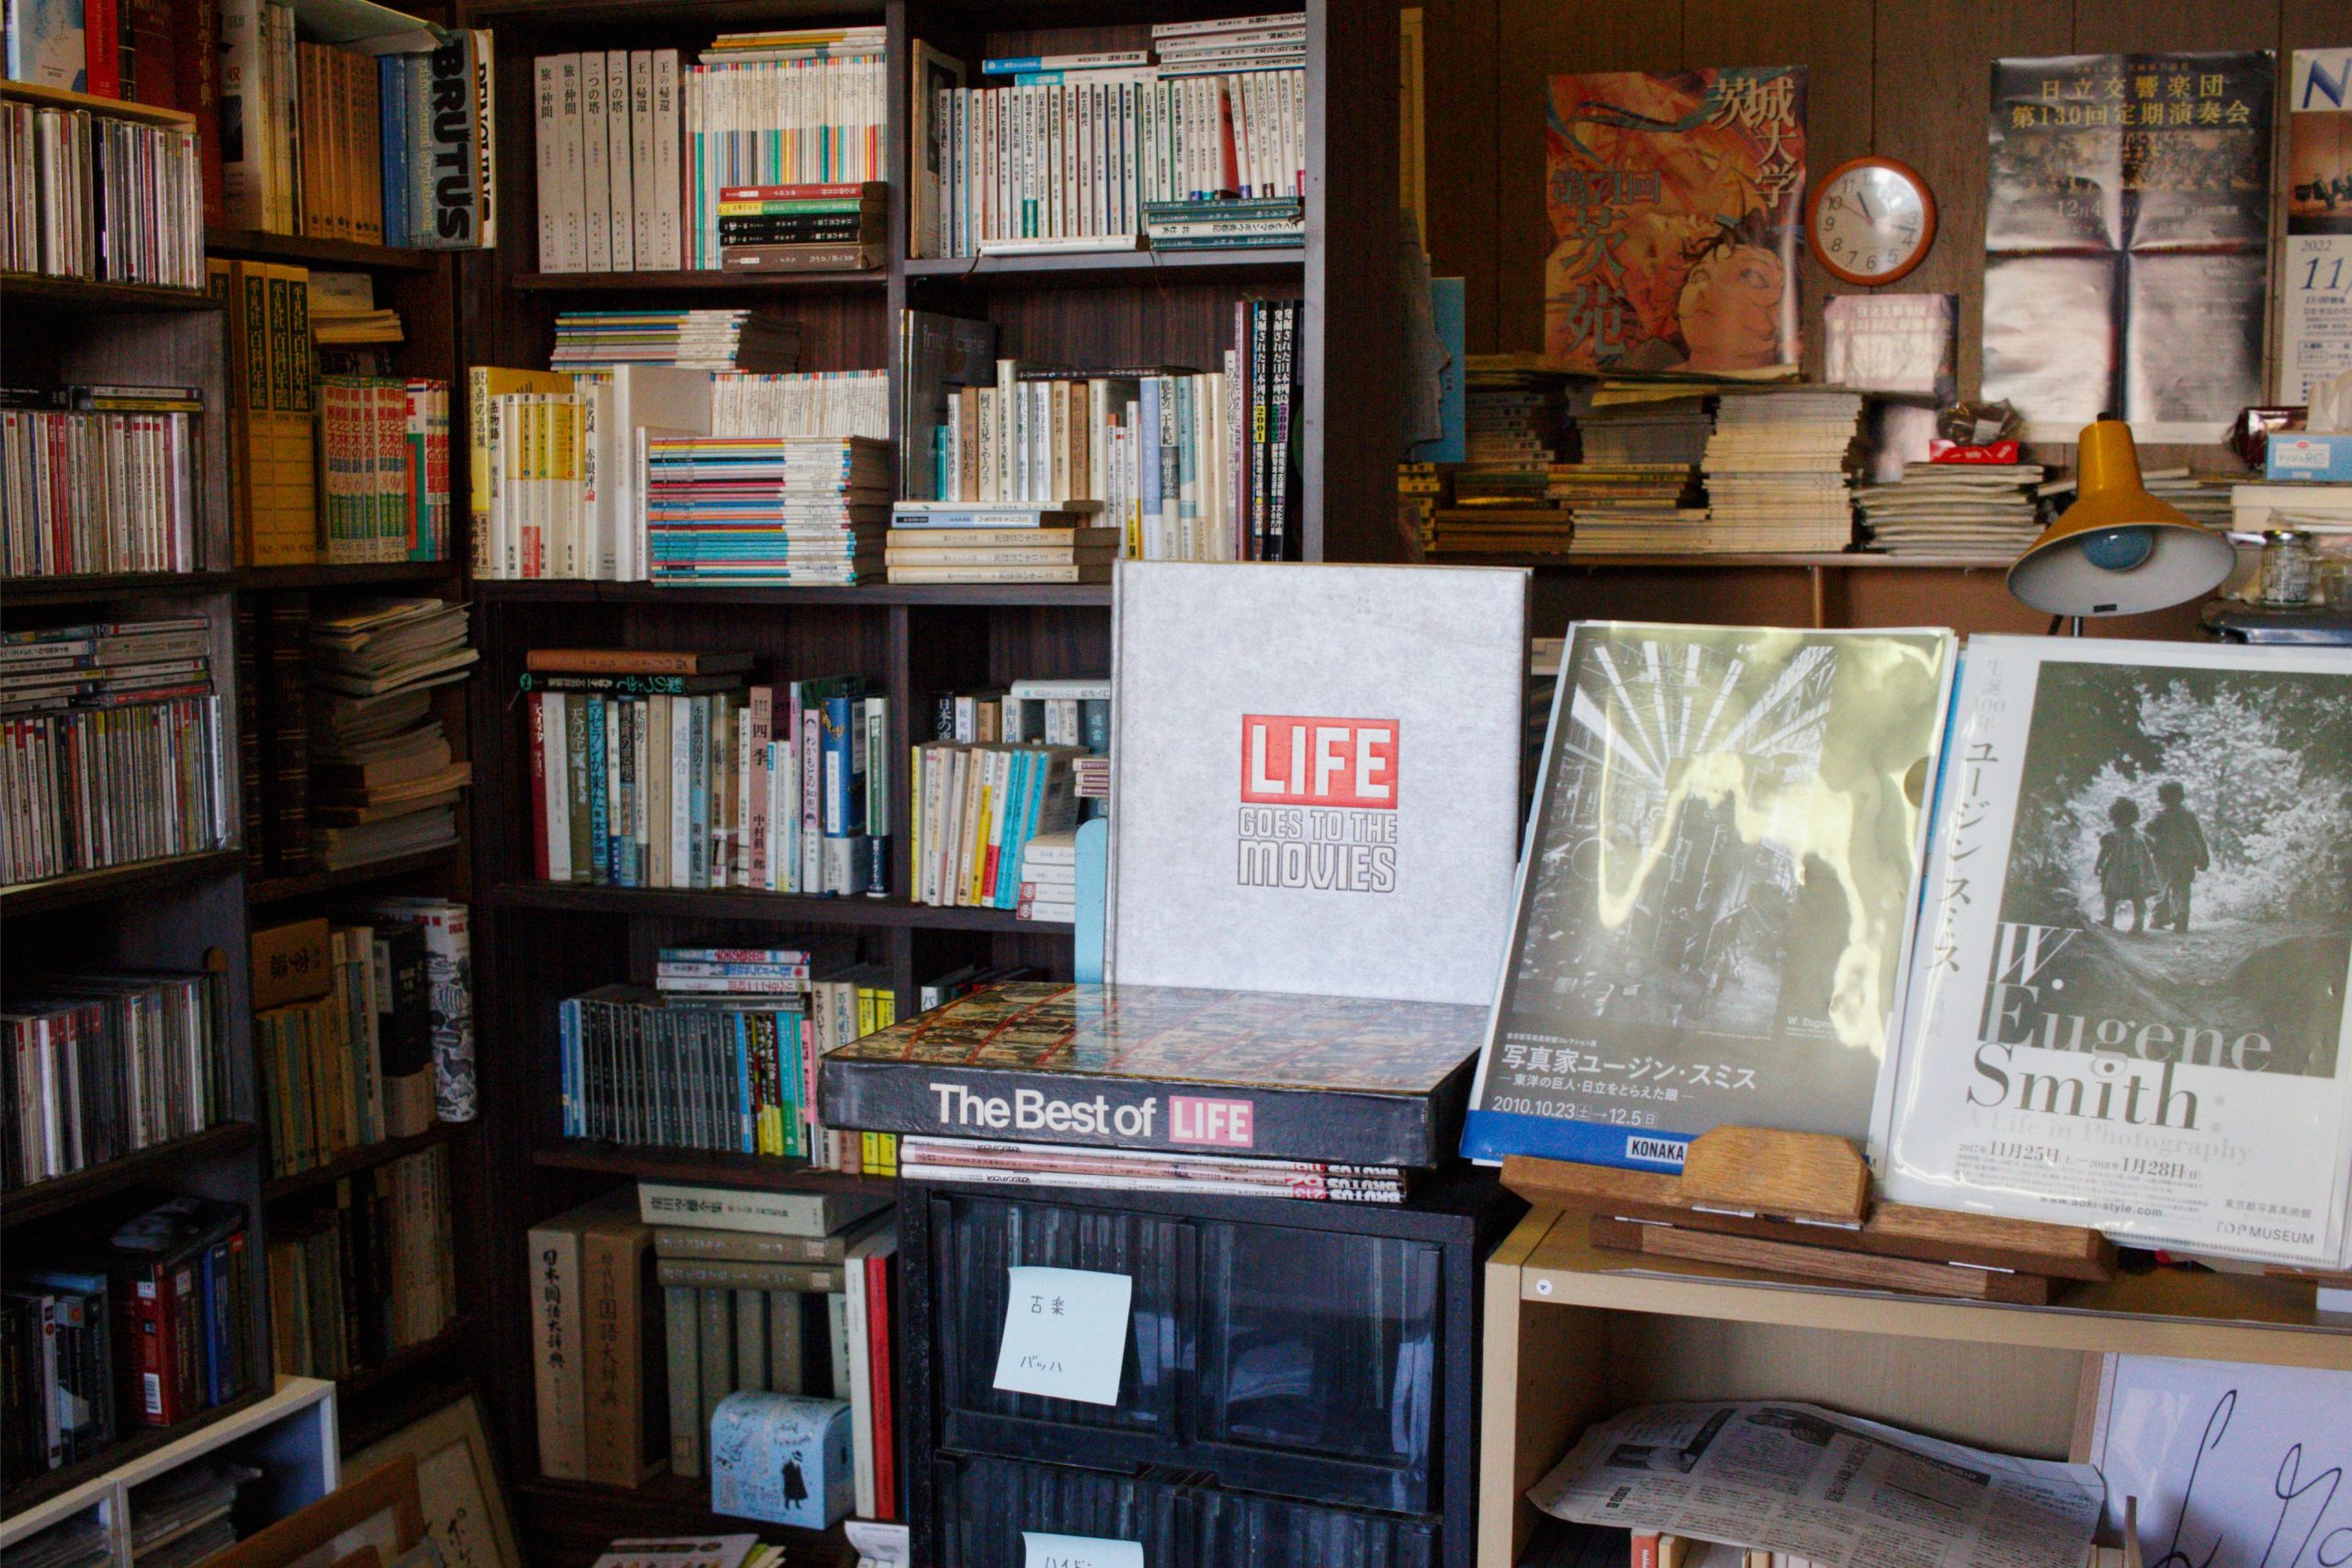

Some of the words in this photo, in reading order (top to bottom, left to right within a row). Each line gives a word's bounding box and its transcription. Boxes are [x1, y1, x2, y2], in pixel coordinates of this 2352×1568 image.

[541, 68, 553, 118] 旅の仲間
[564, 64, 576, 115] 旅の仲間
[588, 62, 600, 115] 二つの塔
[612, 62, 624, 114] 二つの塔
[636, 62, 648, 113] 王の帰還
[659, 62, 671, 113] 王の帰還
[2041, 73, 2224, 101] 日立交響楽団
[2011, 99, 2251, 130] 第130回定期演奏会
[432, 38, 474, 241] BRUTUS
[1706, 76, 1798, 209] 茨城大学
[1824, 217, 1836, 231] 9
[1827, 196, 1843, 211] 10
[1831, 238, 1843, 254] 8
[1846, 250, 1859, 265] 7
[1866, 254, 1878, 270] 6
[1886, 249, 1899, 265] 5
[2300, 240, 2333, 253] 2022
[1257, 310, 1267, 405] 発掘された日本列島
[1272, 310, 1283, 405] 発掘された日本列島
[1282, 308, 1293, 405] 発掘された日本列島
[473, 372, 488, 448] 85点の言葉
[490, 400, 500, 440] 岳物語
[1161, 380, 1173, 446] 敗北の二十世紀
[1256, 406, 1265, 443] 2001
[1278, 405, 1287, 443] 2003
[979, 393, 991, 484] 何でも見てやろう
[752, 724, 767, 767] 四季
[1250, 724, 1391, 799] LIFE
[1238, 807, 1304, 840] GOES
[1310, 809, 1343, 841] TO
[1351, 812, 1397, 844] THE
[1237, 838, 1396, 893] MOVIES
[1986, 921, 2084, 991] W.
[1984, 983, 2272, 1078] Eugene
[1501, 1043, 1757, 1091] 写真家ユージン・スミス
[930, 1083, 1011, 1129] The
[1015, 1088, 1109, 1134] Best
[1112, 1096, 1157, 1138] of
[1172, 1101, 1250, 1143] LIFE
[1491, 1095, 1576, 1120] 2010.10.23
[1631, 1139, 1684, 1162] KONAKA
[1989, 1140, 2060, 1164] 11月25日
[2121, 1156, 2186, 1179] 1月28日
[2049, 1120, 2074, 1138] in
[2081, 1121, 2253, 1164] Photography
[1329, 1188, 1402, 1203] BRUTUS
[2040, 1194, 2164, 1217] www.aoki-style.com
[1030, 1294, 1065, 1316] 古楽
[1020, 1355, 1063, 1373] バッハ
